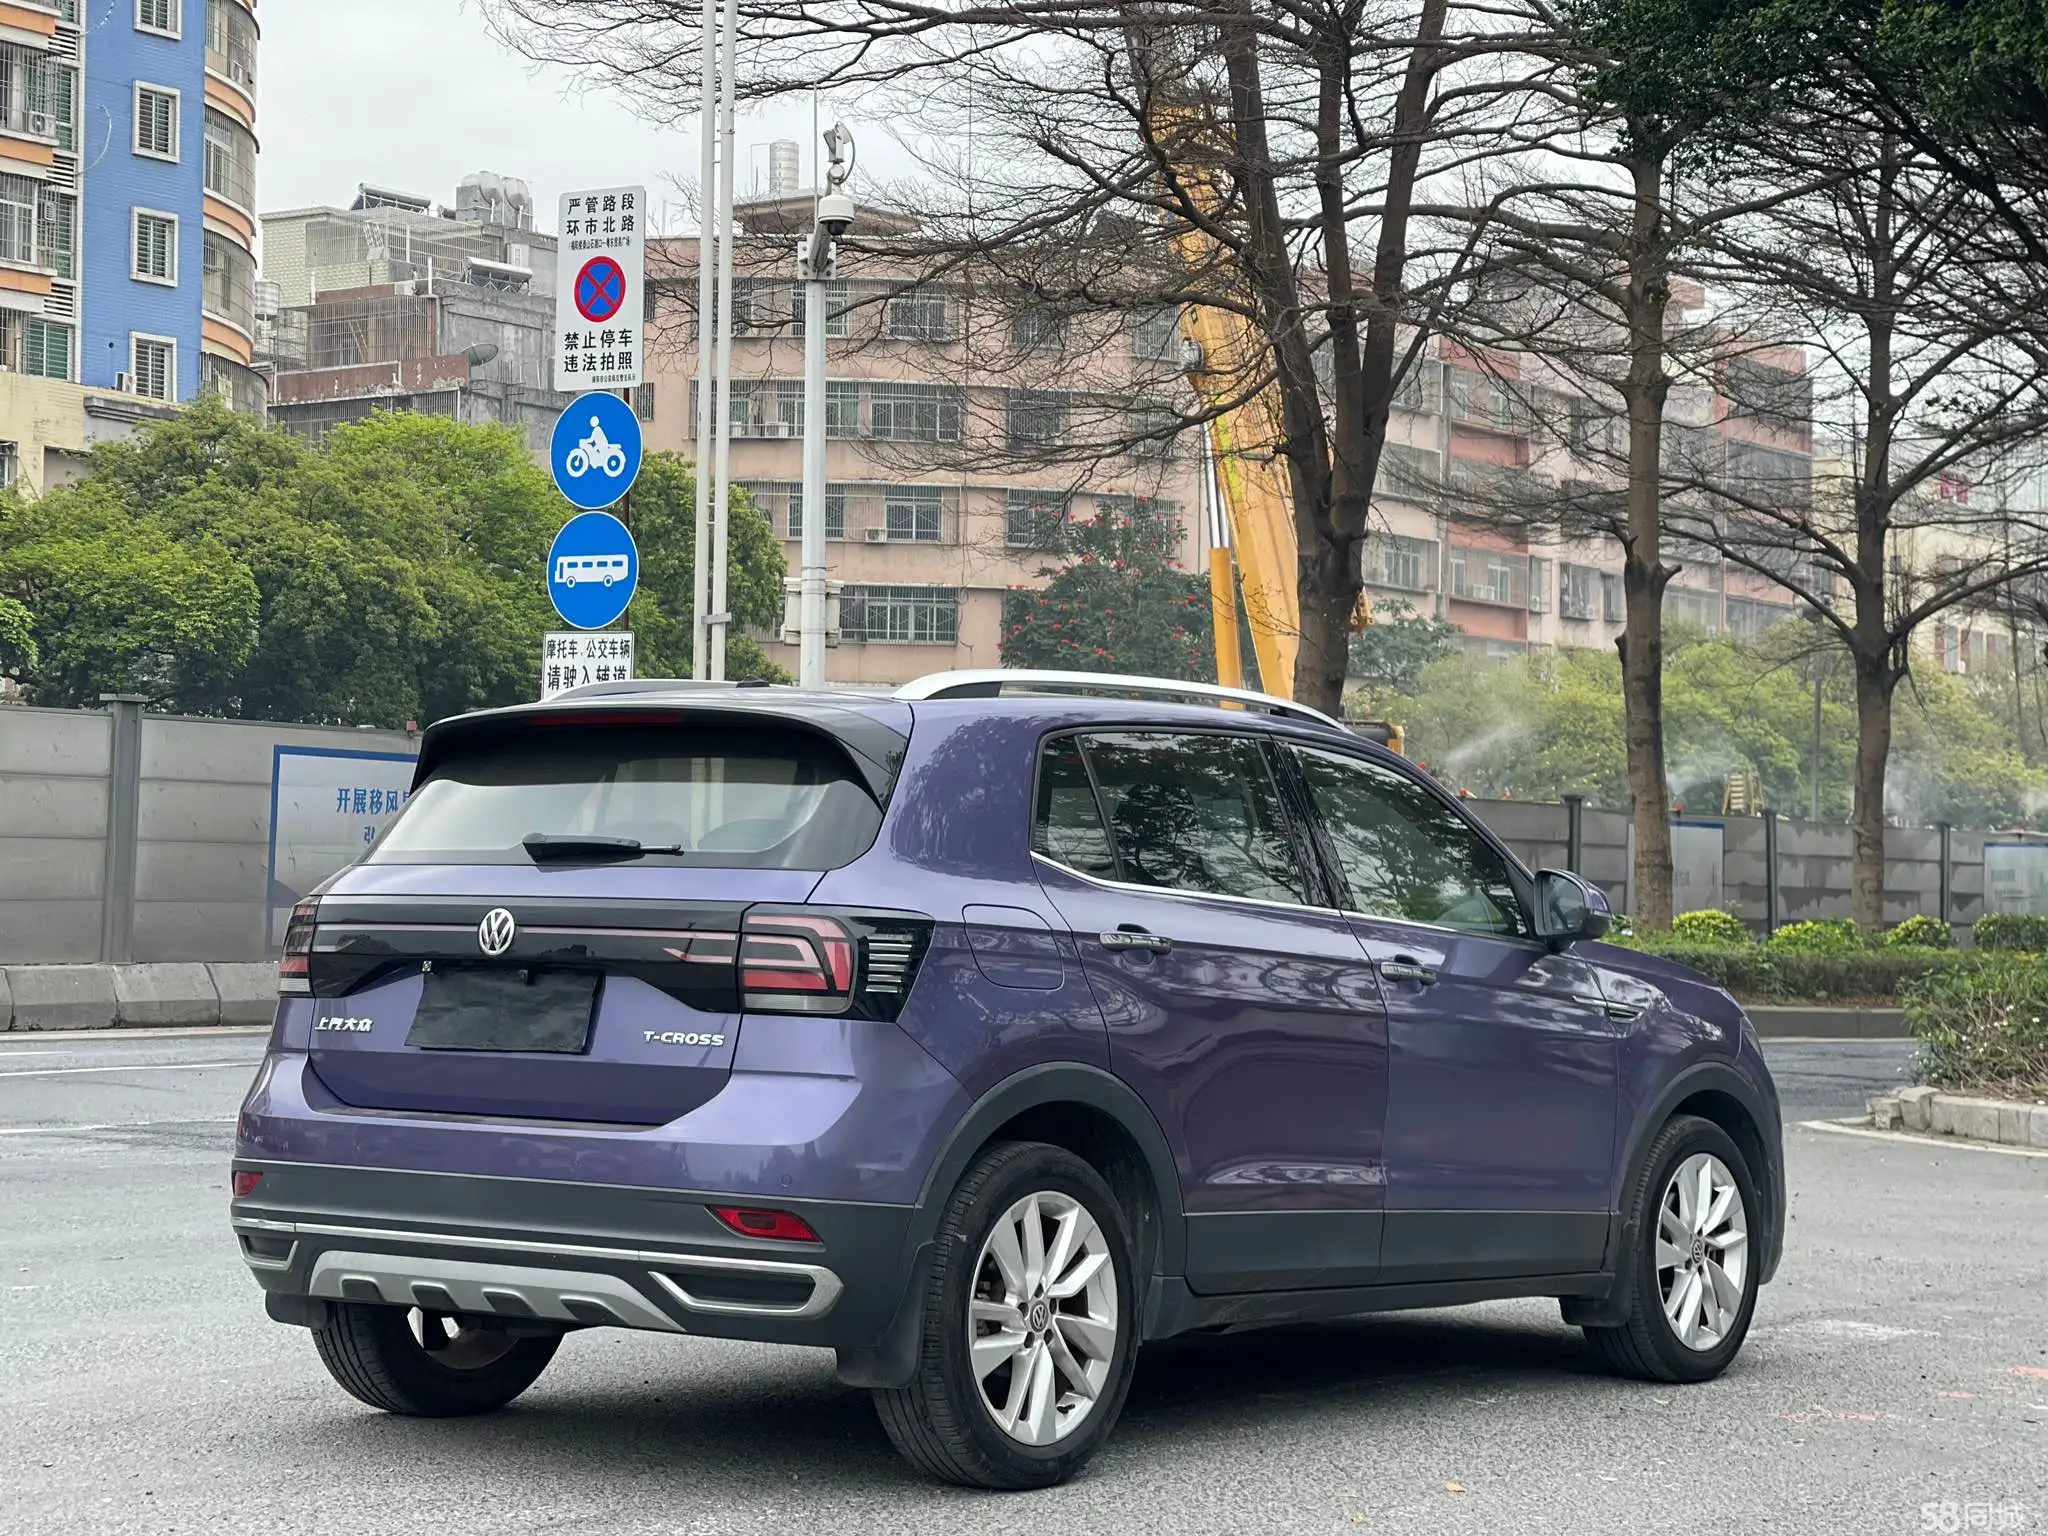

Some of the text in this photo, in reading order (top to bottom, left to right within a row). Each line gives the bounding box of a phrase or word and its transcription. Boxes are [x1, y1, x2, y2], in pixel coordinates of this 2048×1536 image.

[567, 193, 634, 215] 严管路段
[566, 214, 634, 236] 环市北路
[564, 329, 632, 350] 禁止停车
[564, 352, 632, 373] 违法拍照
[643, 1030, 725, 1047] T-CROSS
